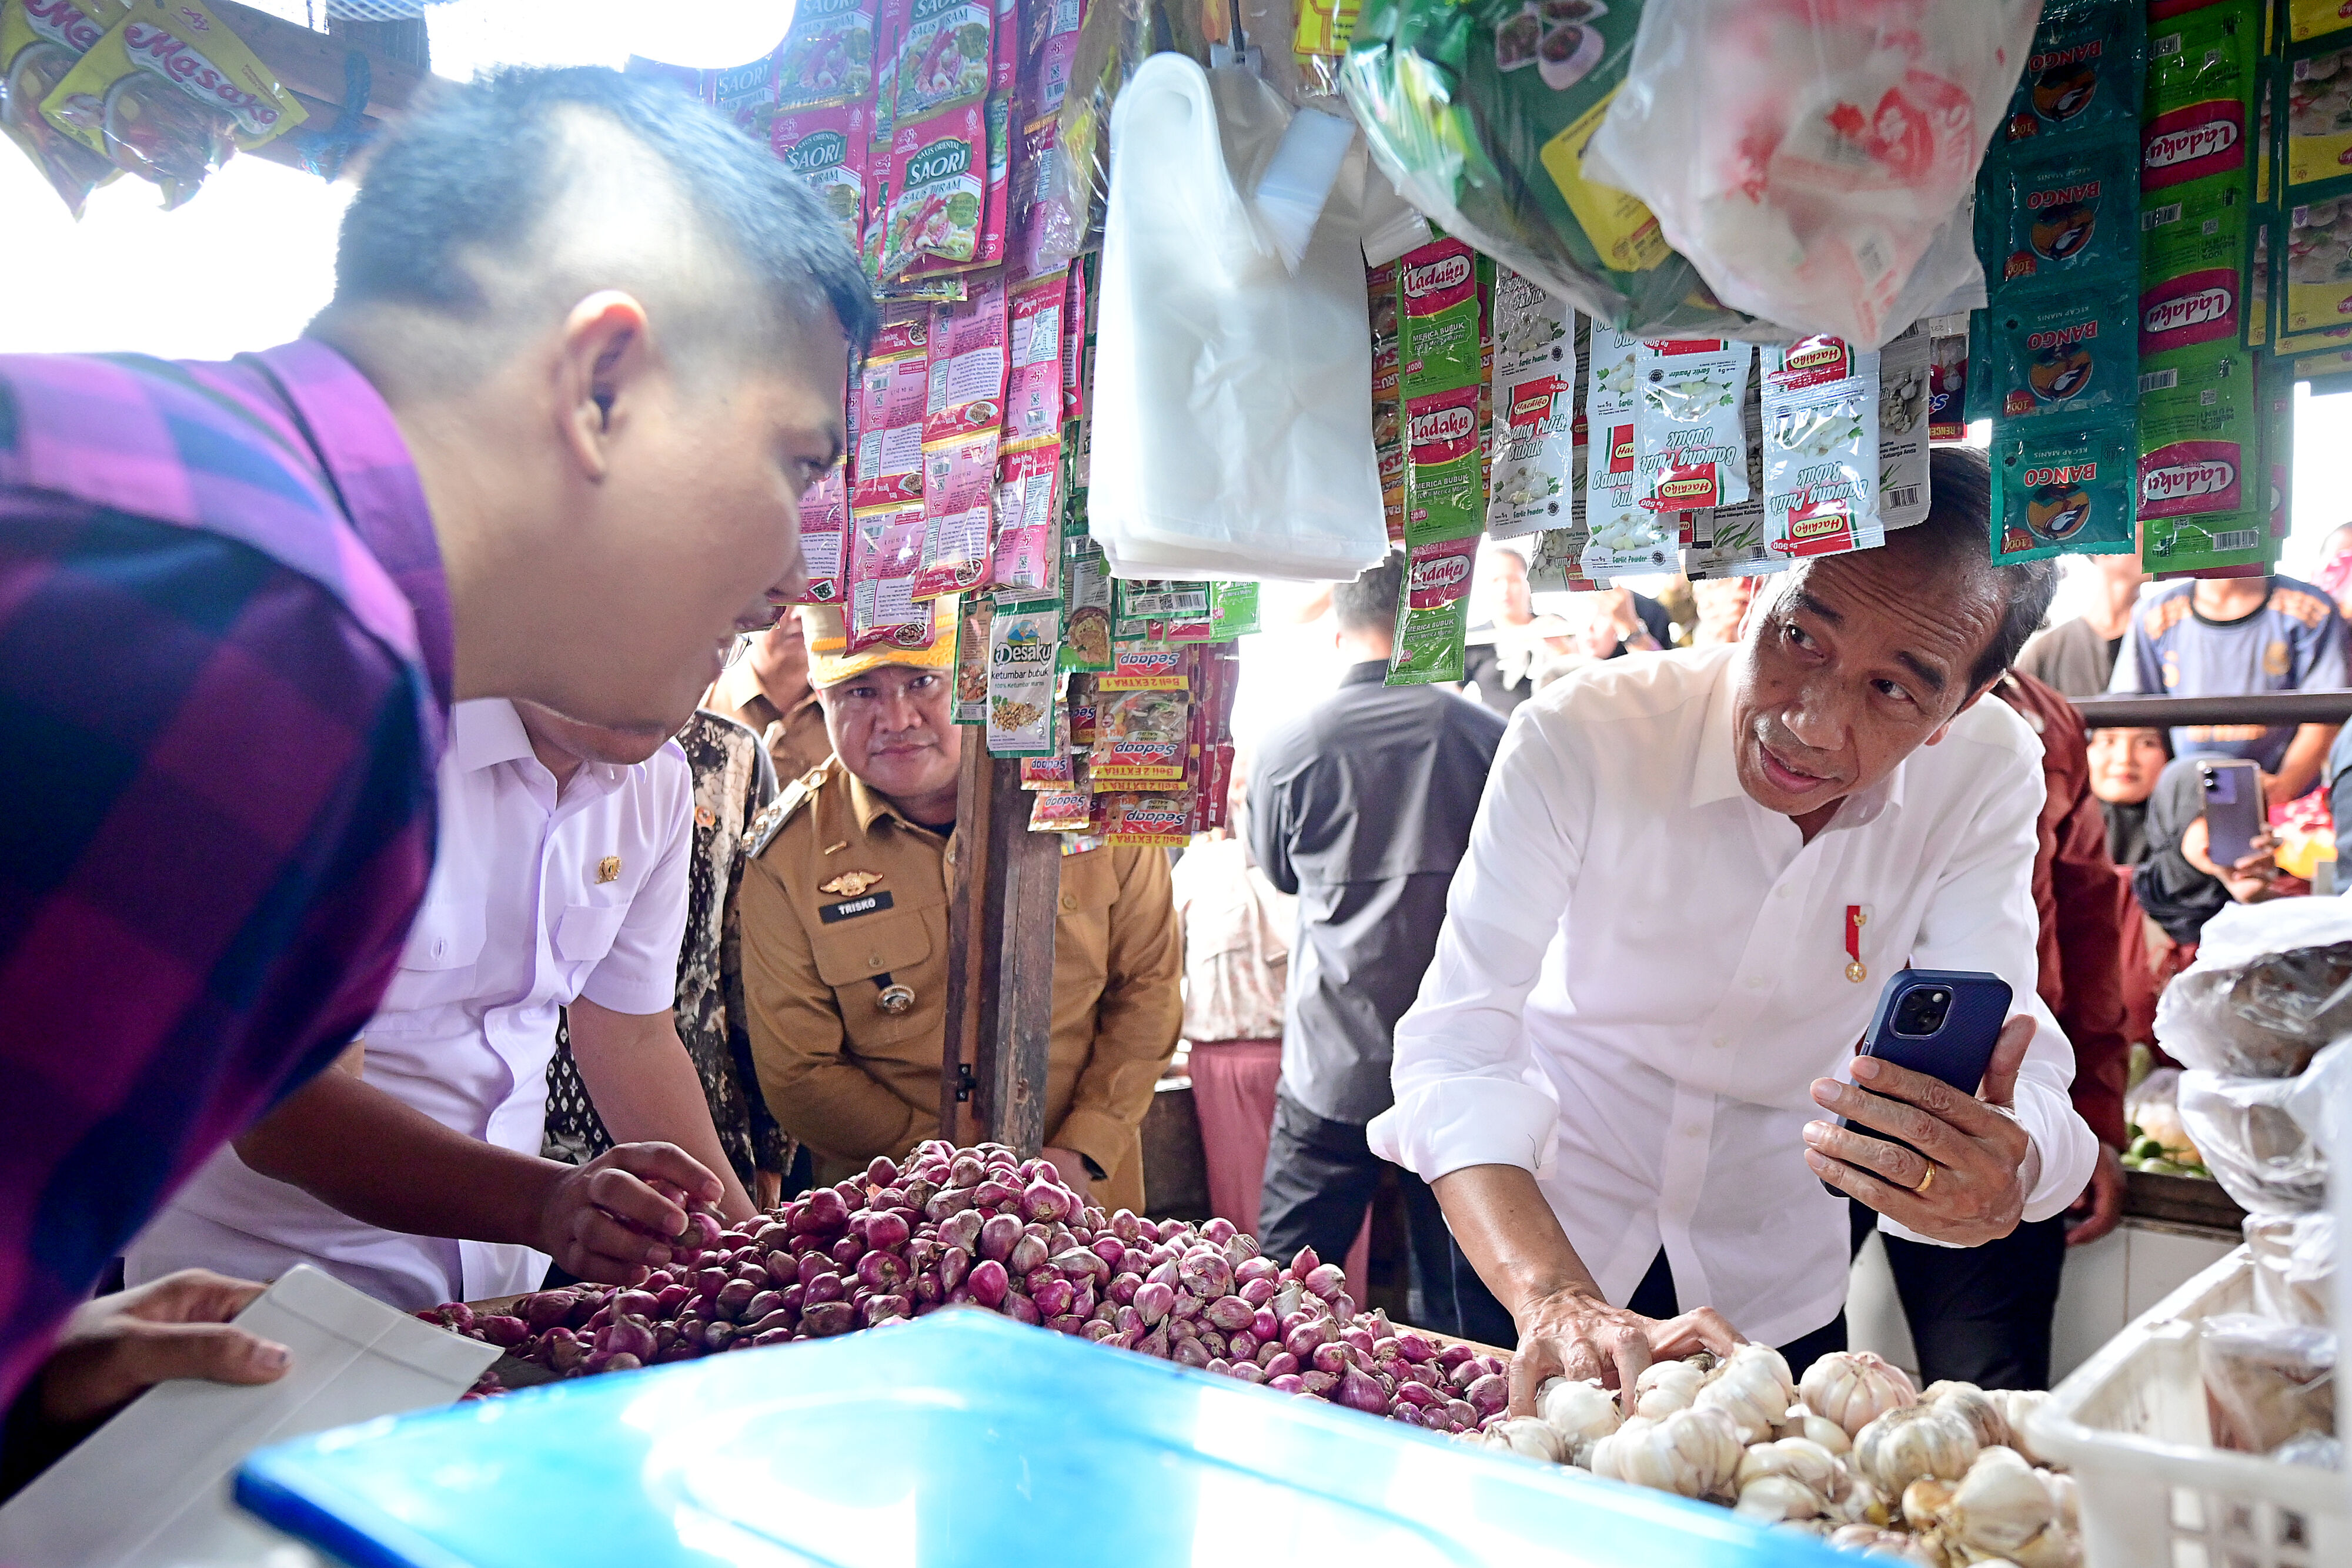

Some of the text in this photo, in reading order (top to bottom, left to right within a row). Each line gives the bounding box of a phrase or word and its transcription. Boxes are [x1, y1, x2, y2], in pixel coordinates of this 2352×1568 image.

[2029, 39, 2102, 71] BANGO
[124, 25, 279, 125] Masako
[719, 64, 769, 94] SAORI
[917, 148, 934, 160] SAUS
[934, 141, 960, 153] ORIENTAL
[2150, 125, 2231, 161] Ladaku
[790, 142, 840, 170] SAORI
[910, 149, 966, 185] SAORI
[903, 188, 927, 204] SAUS
[2026, 180, 2101, 209] BANGO
[1408, 260, 1465, 292] Ladaku
[2037, 306, 2089, 321] KECAP MANIS
[2148, 293, 2224, 327] Ladaku
[1412, 322, 1465, 342] MERICA BUBUK
[2027, 320, 2099, 351] BANGO
[1793, 349, 1838, 366] Hachiko
[1669, 369, 1691, 378] Powder
[1515, 396, 1548, 412] Hachiko
[1618, 399, 1634, 407] Garlic
[1411, 412, 1468, 440] Ladaku
[1536, 413, 1566, 436] Putih
[1666, 426, 1713, 451] Bubuk
[1508, 439, 1543, 462] Bubuk
[1882, 451, 1903, 460] Keluarga
[2034, 447, 2088, 459] KECAP MANIS
[1639, 446, 1737, 476] Bawang Putih
[1415, 474, 1469, 490] MERICA BUBUK
[1592, 470, 1634, 490] Bawan
[1796, 461, 1843, 489] Bubuk
[2024, 462, 2097, 487] BANGO
[2147, 466, 2227, 494] Ladaku
[1433, 488, 1451, 496] Merica
[1665, 482, 1709, 494] Hachiko
[1806, 479, 1868, 504] Bawang
[1612, 489, 1633, 508] Bub
[1769, 491, 1806, 516] Putih
[1514, 507, 1544, 519] Garlic Powder
[1795, 519, 1840, 534] Hachiko
[1772, 542, 1789, 550] 500
[1554, 556, 1572, 570] Putih
[1612, 555, 1628, 564] Garlic
[1628, 554, 1647, 563] Powder
[1411, 559, 1464, 586] Ladaku
[1406, 618, 1454, 633] MERICA BUBUK
[994, 636, 1053, 666] Desaku
[1120, 652, 1179, 668] Sedaap
[991, 668, 1049, 680] ketumbar bubuk
[1150, 678, 1157, 686] 2
[1159, 678, 1181, 686] Beli
[1114, 678, 1150, 687] EXTRA
[1113, 742, 1178, 757] Sedaap
[1031, 758, 1067, 771] Sedaap
[1105, 767, 1142, 776] EXTRA
[1144, 768, 1150, 776] 2
[1152, 768, 1174, 777] Beli
[1102, 782, 1180, 791] Beli 2 EXTRA 1
[1045, 795, 1087, 808] Sedaap
[1125, 810, 1187, 825] Sedaap
[1116, 835, 1152, 844] EXTRA
[1154, 836, 1161, 844] 2
[1163, 836, 1184, 845] Beli
[838, 897, 876, 915] TRISKO
